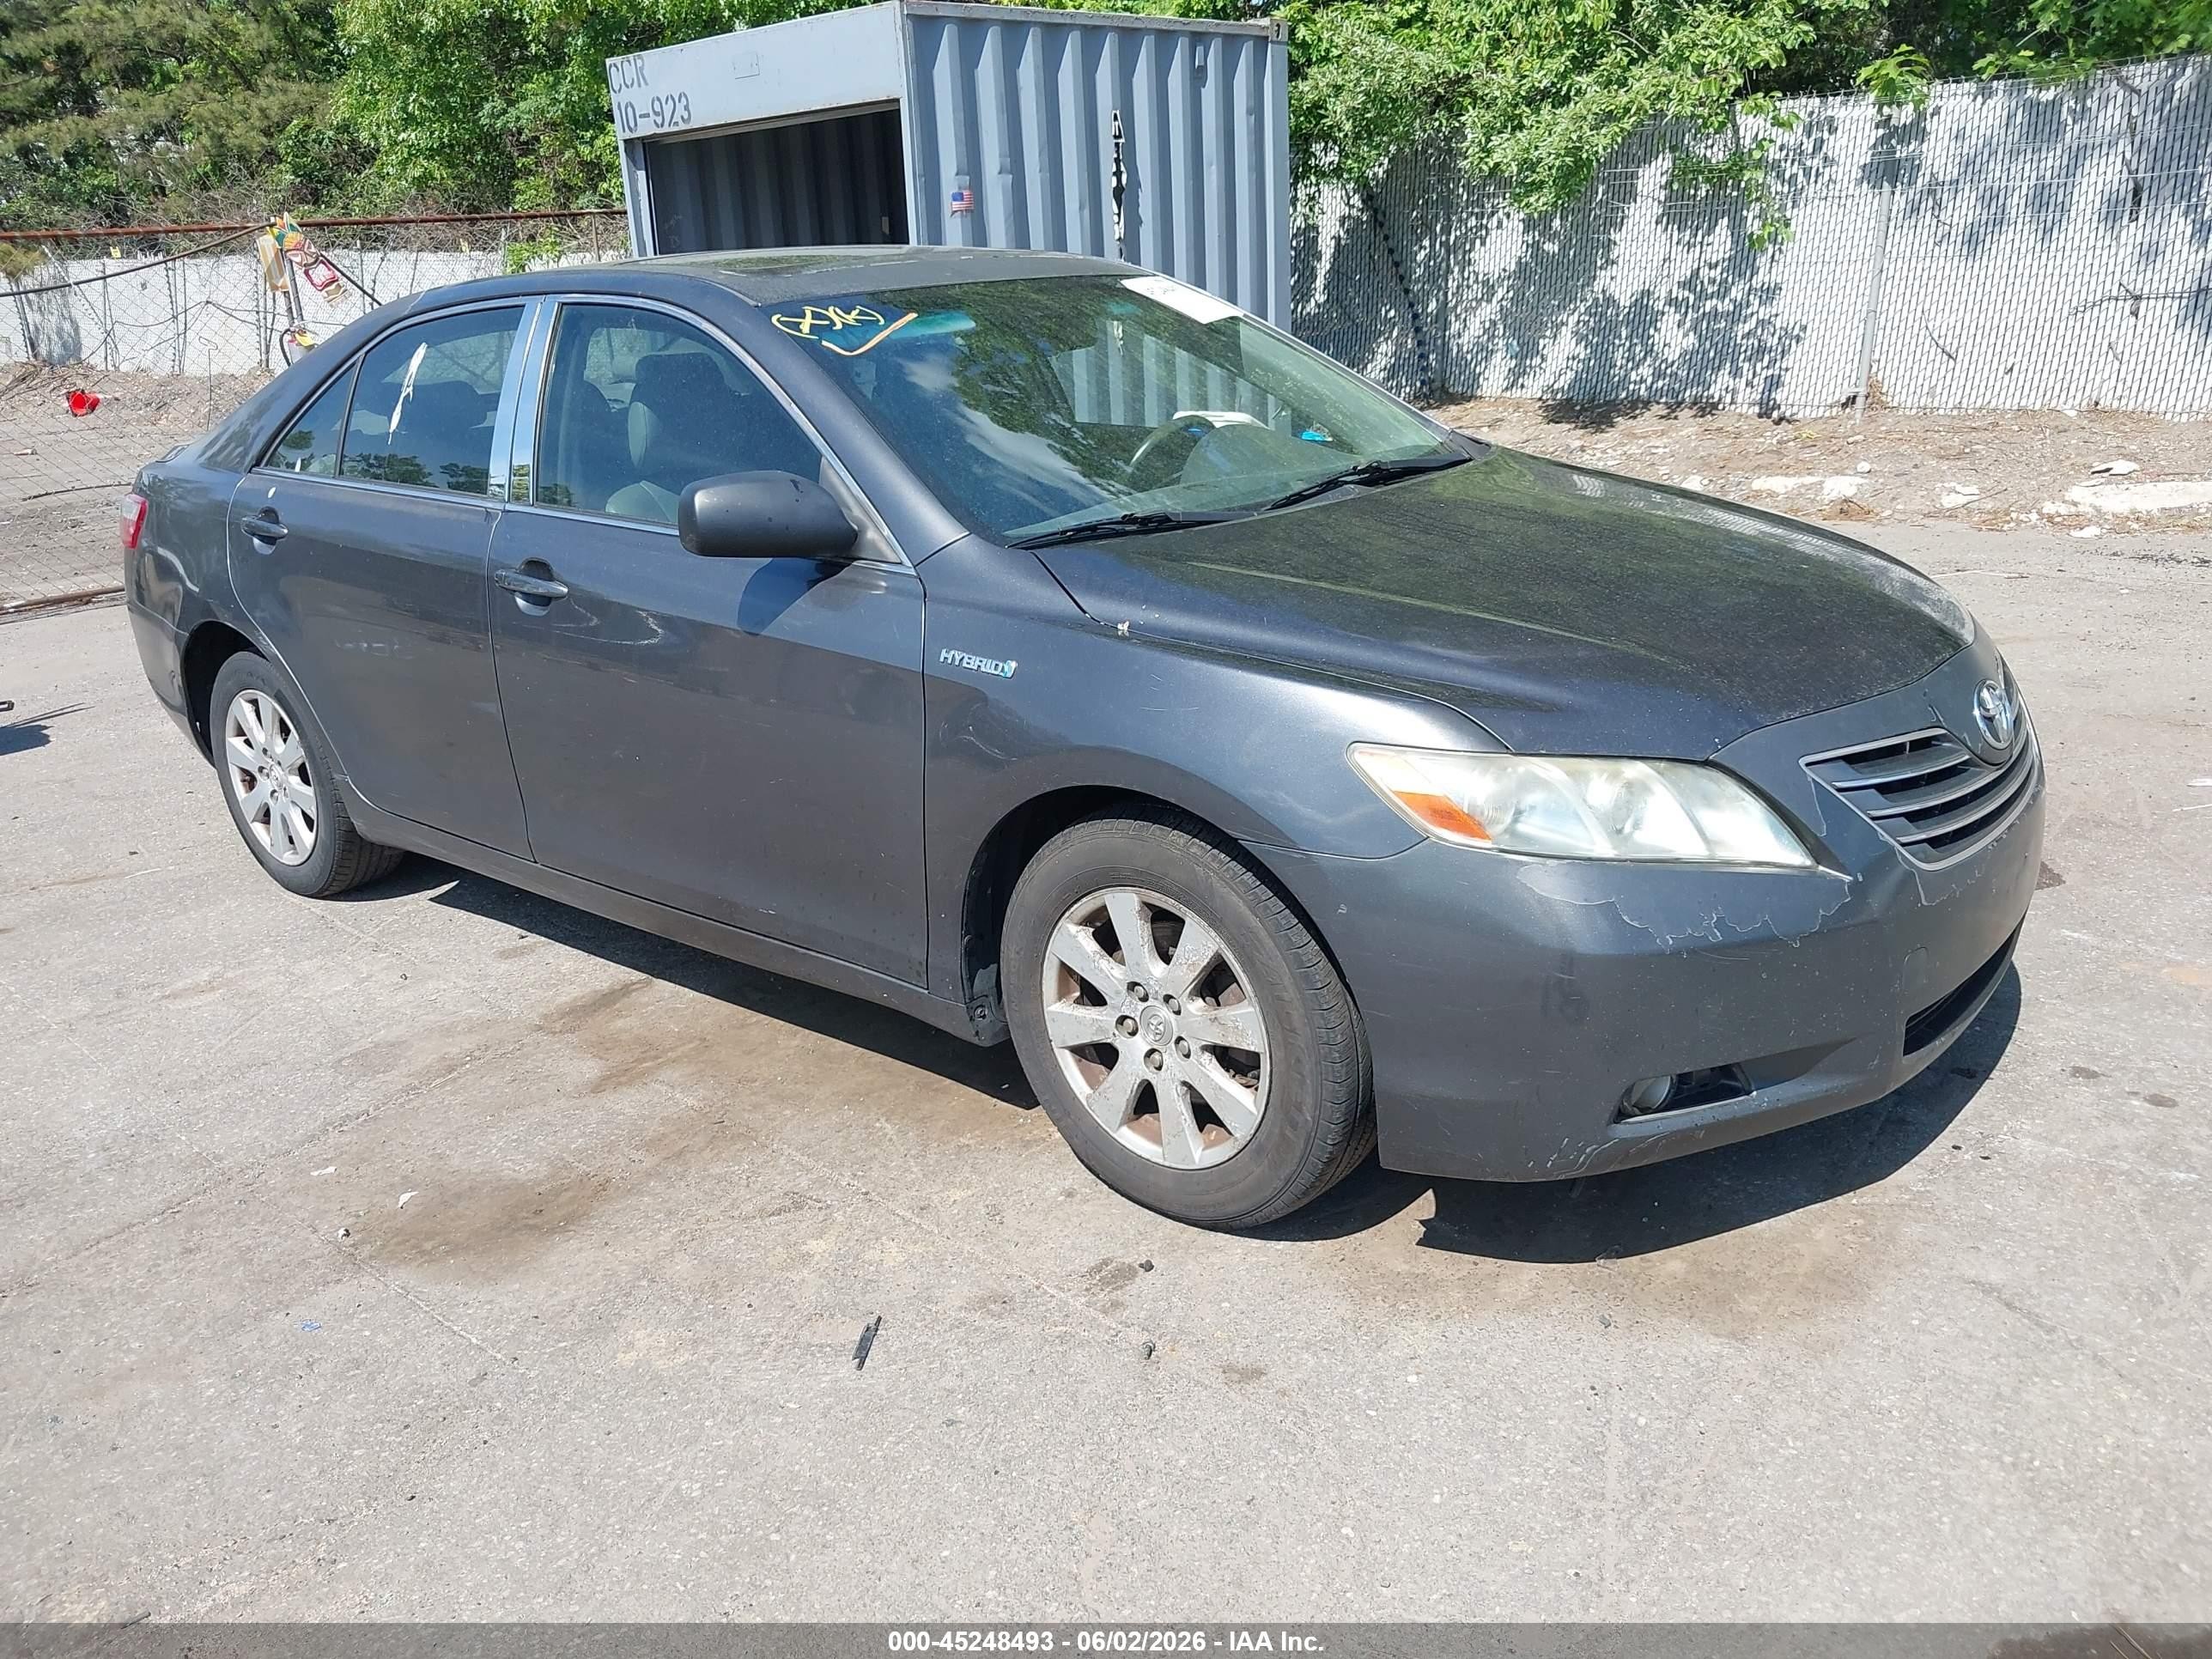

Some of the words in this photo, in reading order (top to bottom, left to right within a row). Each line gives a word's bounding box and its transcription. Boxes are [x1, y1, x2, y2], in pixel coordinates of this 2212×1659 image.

[608, 54, 649, 94] CCR
[617, 91, 692, 134] 10-923
[939, 648, 1004, 676] HYBRID
